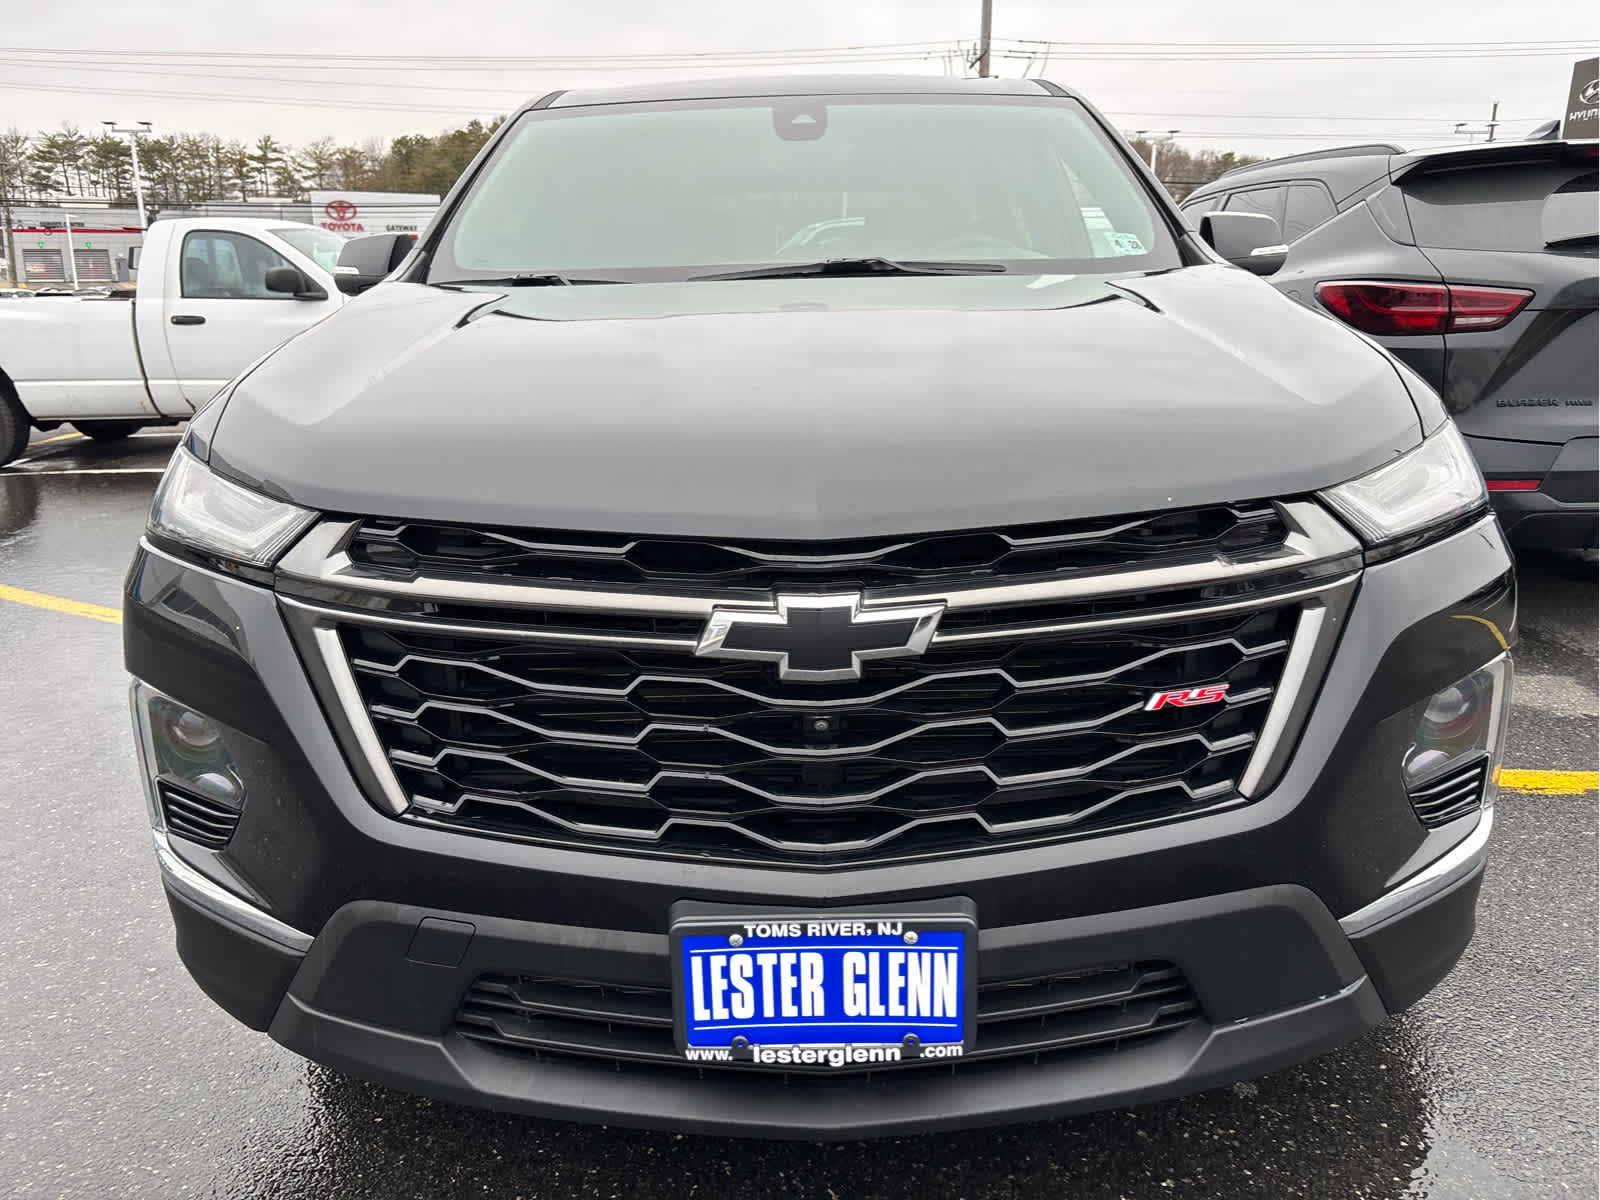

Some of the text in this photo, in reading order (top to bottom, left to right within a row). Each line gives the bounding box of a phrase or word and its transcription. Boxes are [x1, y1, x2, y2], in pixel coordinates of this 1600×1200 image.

[321, 222, 364, 232] TOYOTA
[1496, 399, 1560, 408] BLAZER
[1144, 684, 1230, 711] RS
[744, 922, 903, 938] TOMS RIVER, NJ
[691, 952, 958, 1021] LESTER GLENN
[753, 1044, 901, 1067] lesterglenn
